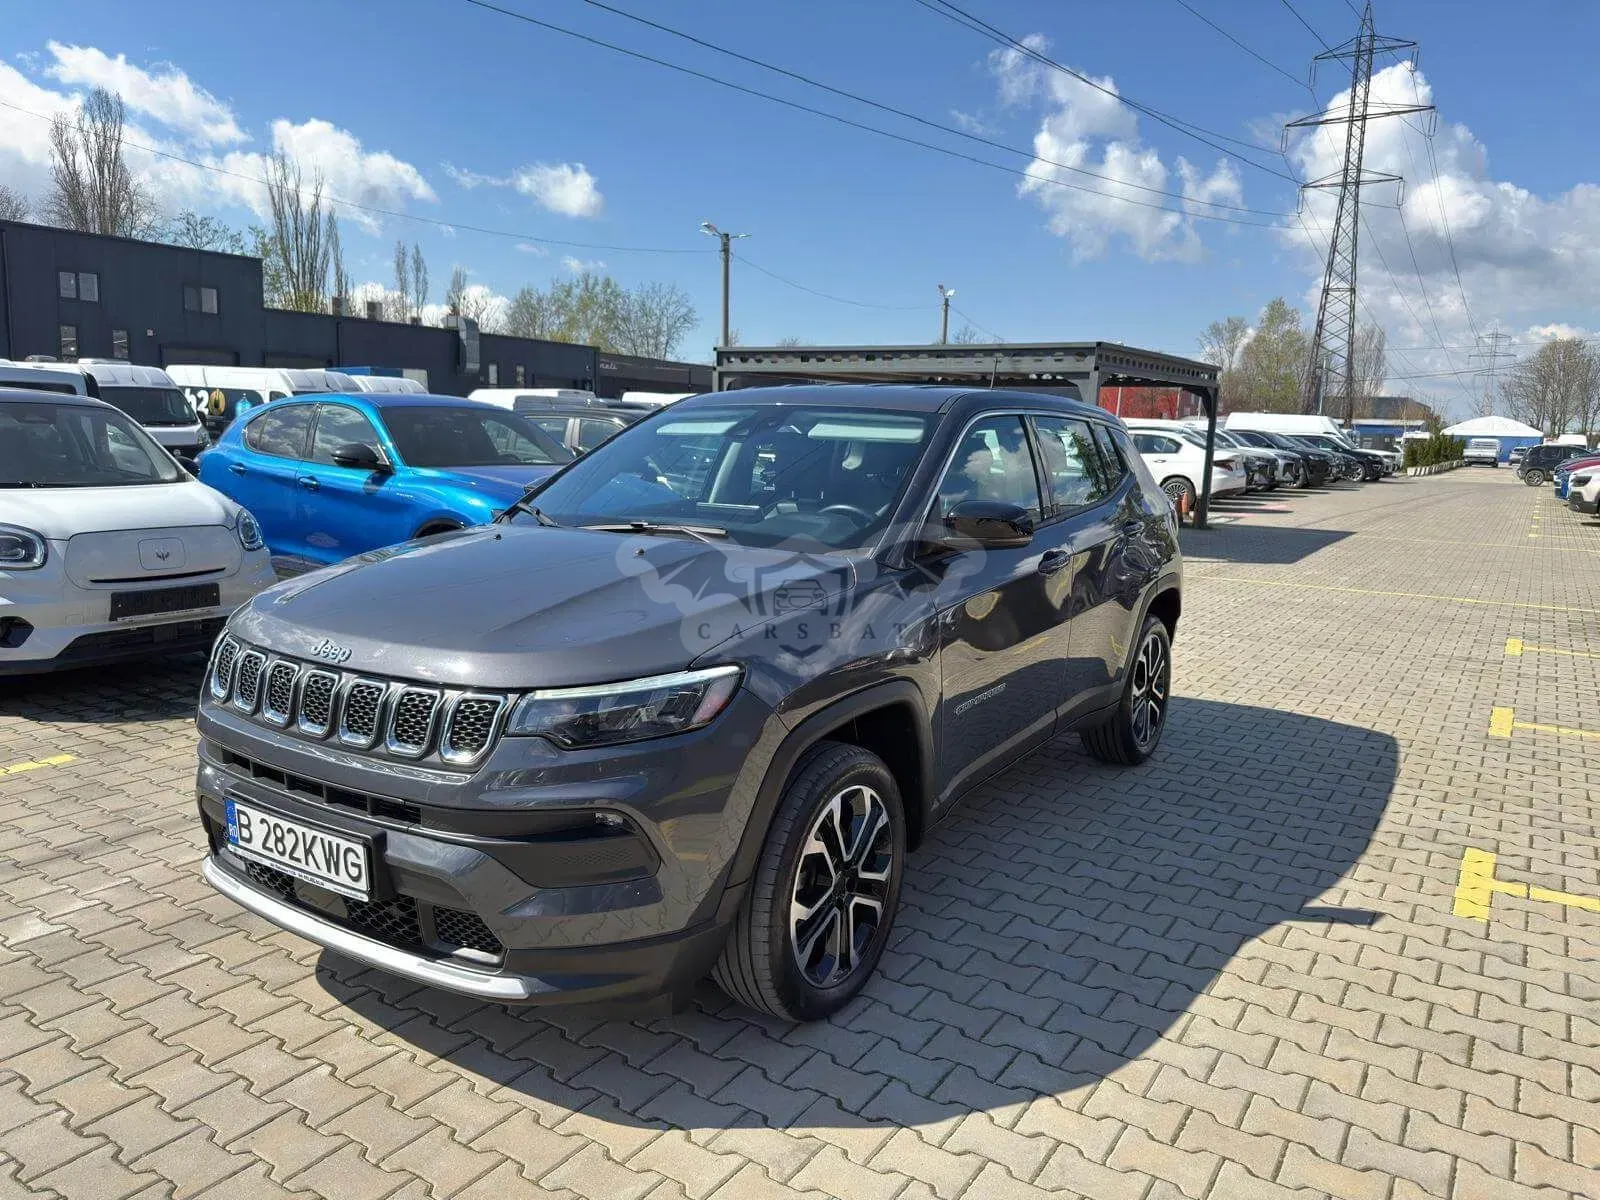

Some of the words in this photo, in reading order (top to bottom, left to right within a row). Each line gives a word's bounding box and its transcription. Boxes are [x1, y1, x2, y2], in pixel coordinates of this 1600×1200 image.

[311, 639, 353, 665] Jeep
[236, 808, 253, 844] B
[260, 817, 363, 883] 282KWG
